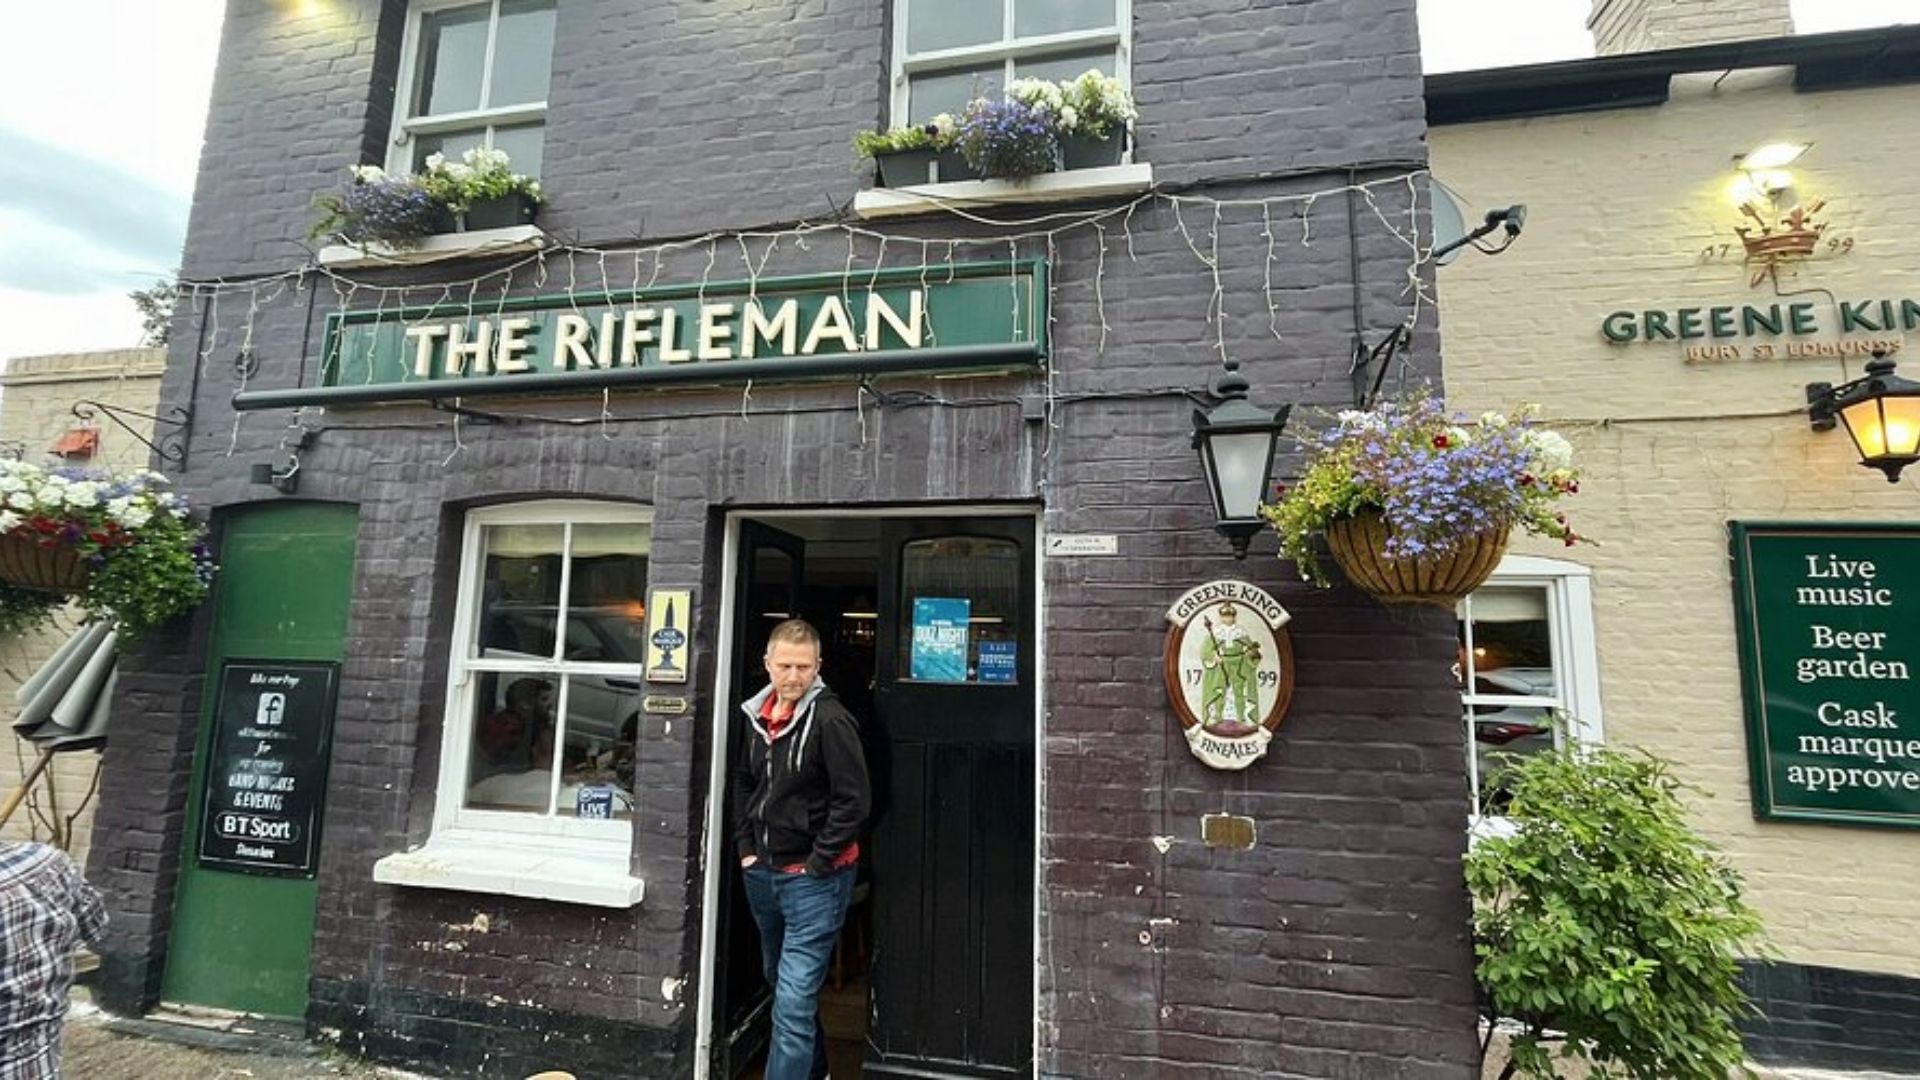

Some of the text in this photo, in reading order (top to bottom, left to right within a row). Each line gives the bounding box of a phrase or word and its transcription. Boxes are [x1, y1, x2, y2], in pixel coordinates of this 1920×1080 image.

[1828, 237, 1854, 254] 99
[406, 288, 925, 376] THE RIFLEMAN
[1602, 302, 1819, 342] GREENE
[1686, 343, 1742, 362] BURY
[1786, 338, 1902, 360] EDMUNDS
[1806, 554, 1876, 579] Live
[1176, 583, 1282, 620] GREENE KING
[1797, 582, 1892, 607] music
[1811, 625, 1887, 650] Beer
[1186, 669, 1277, 688] 17 99
[1797, 652, 1910, 683] garden
[1817, 701, 1898, 729] Cask
[1201, 738, 1260, 759] FINE ALES
[1798, 734, 1920, 764] marque
[233, 791, 283, 811] & EVENTS
[250, 817, 291, 840] Sport
